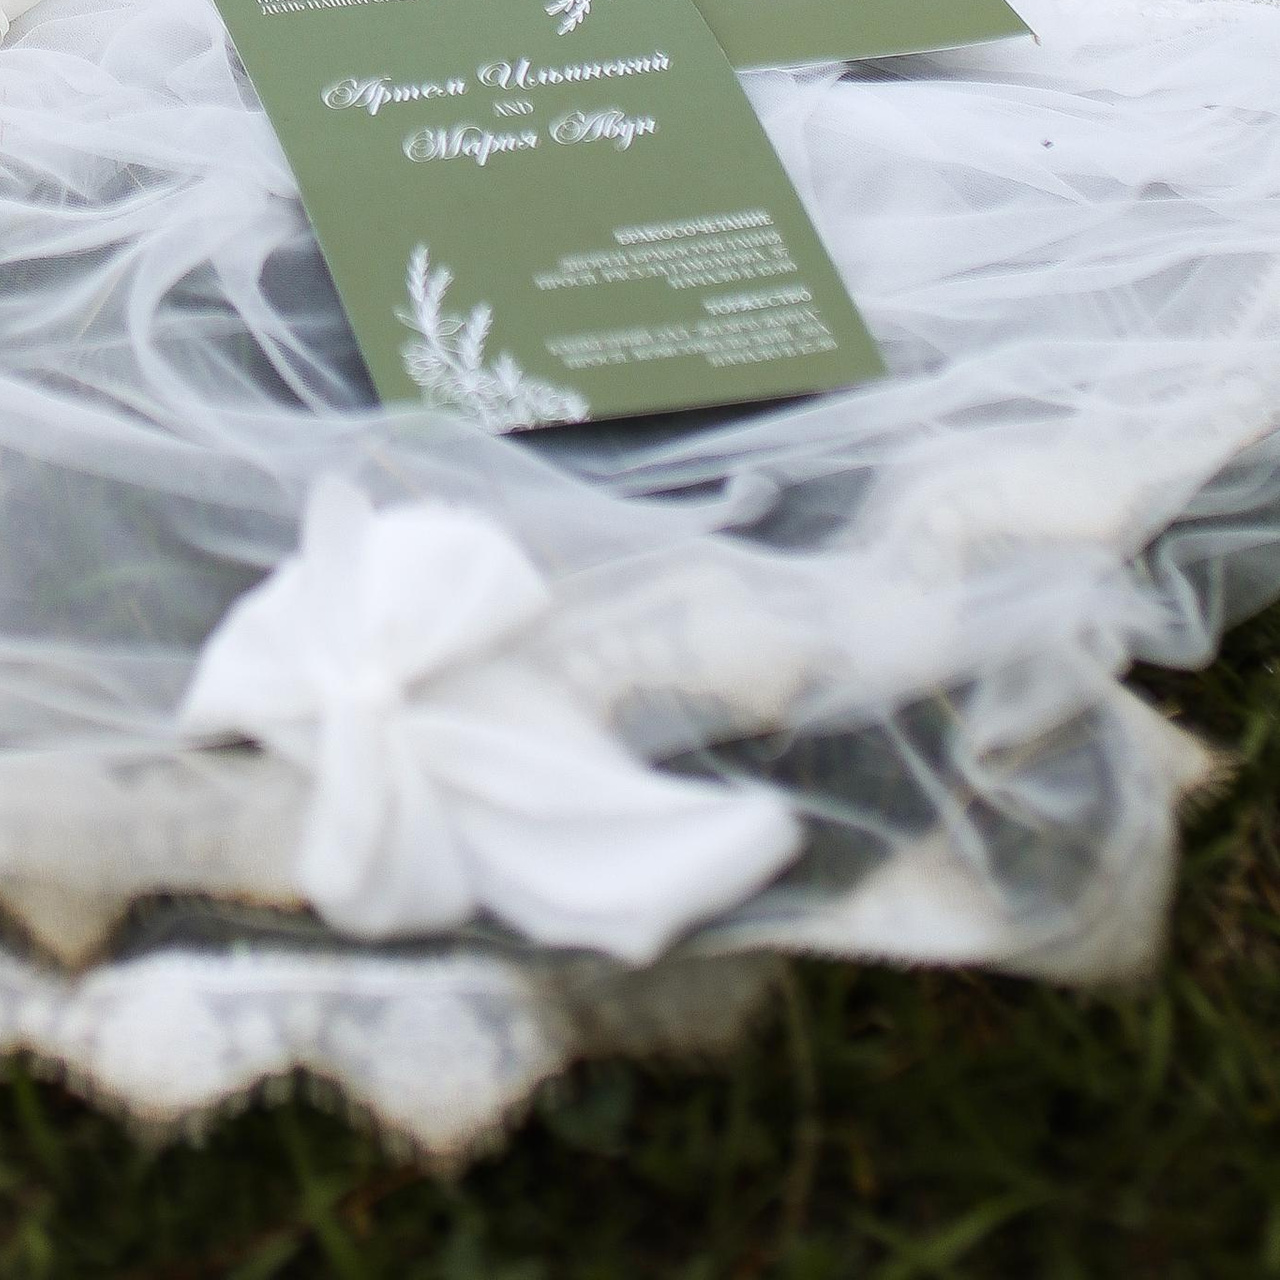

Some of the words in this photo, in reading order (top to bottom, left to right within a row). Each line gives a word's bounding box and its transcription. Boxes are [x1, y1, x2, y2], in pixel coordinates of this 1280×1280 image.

[323, 77, 467, 116] Артем
[477, 49, 672, 91] Ильинский
[405, 126, 540, 167] Мария
